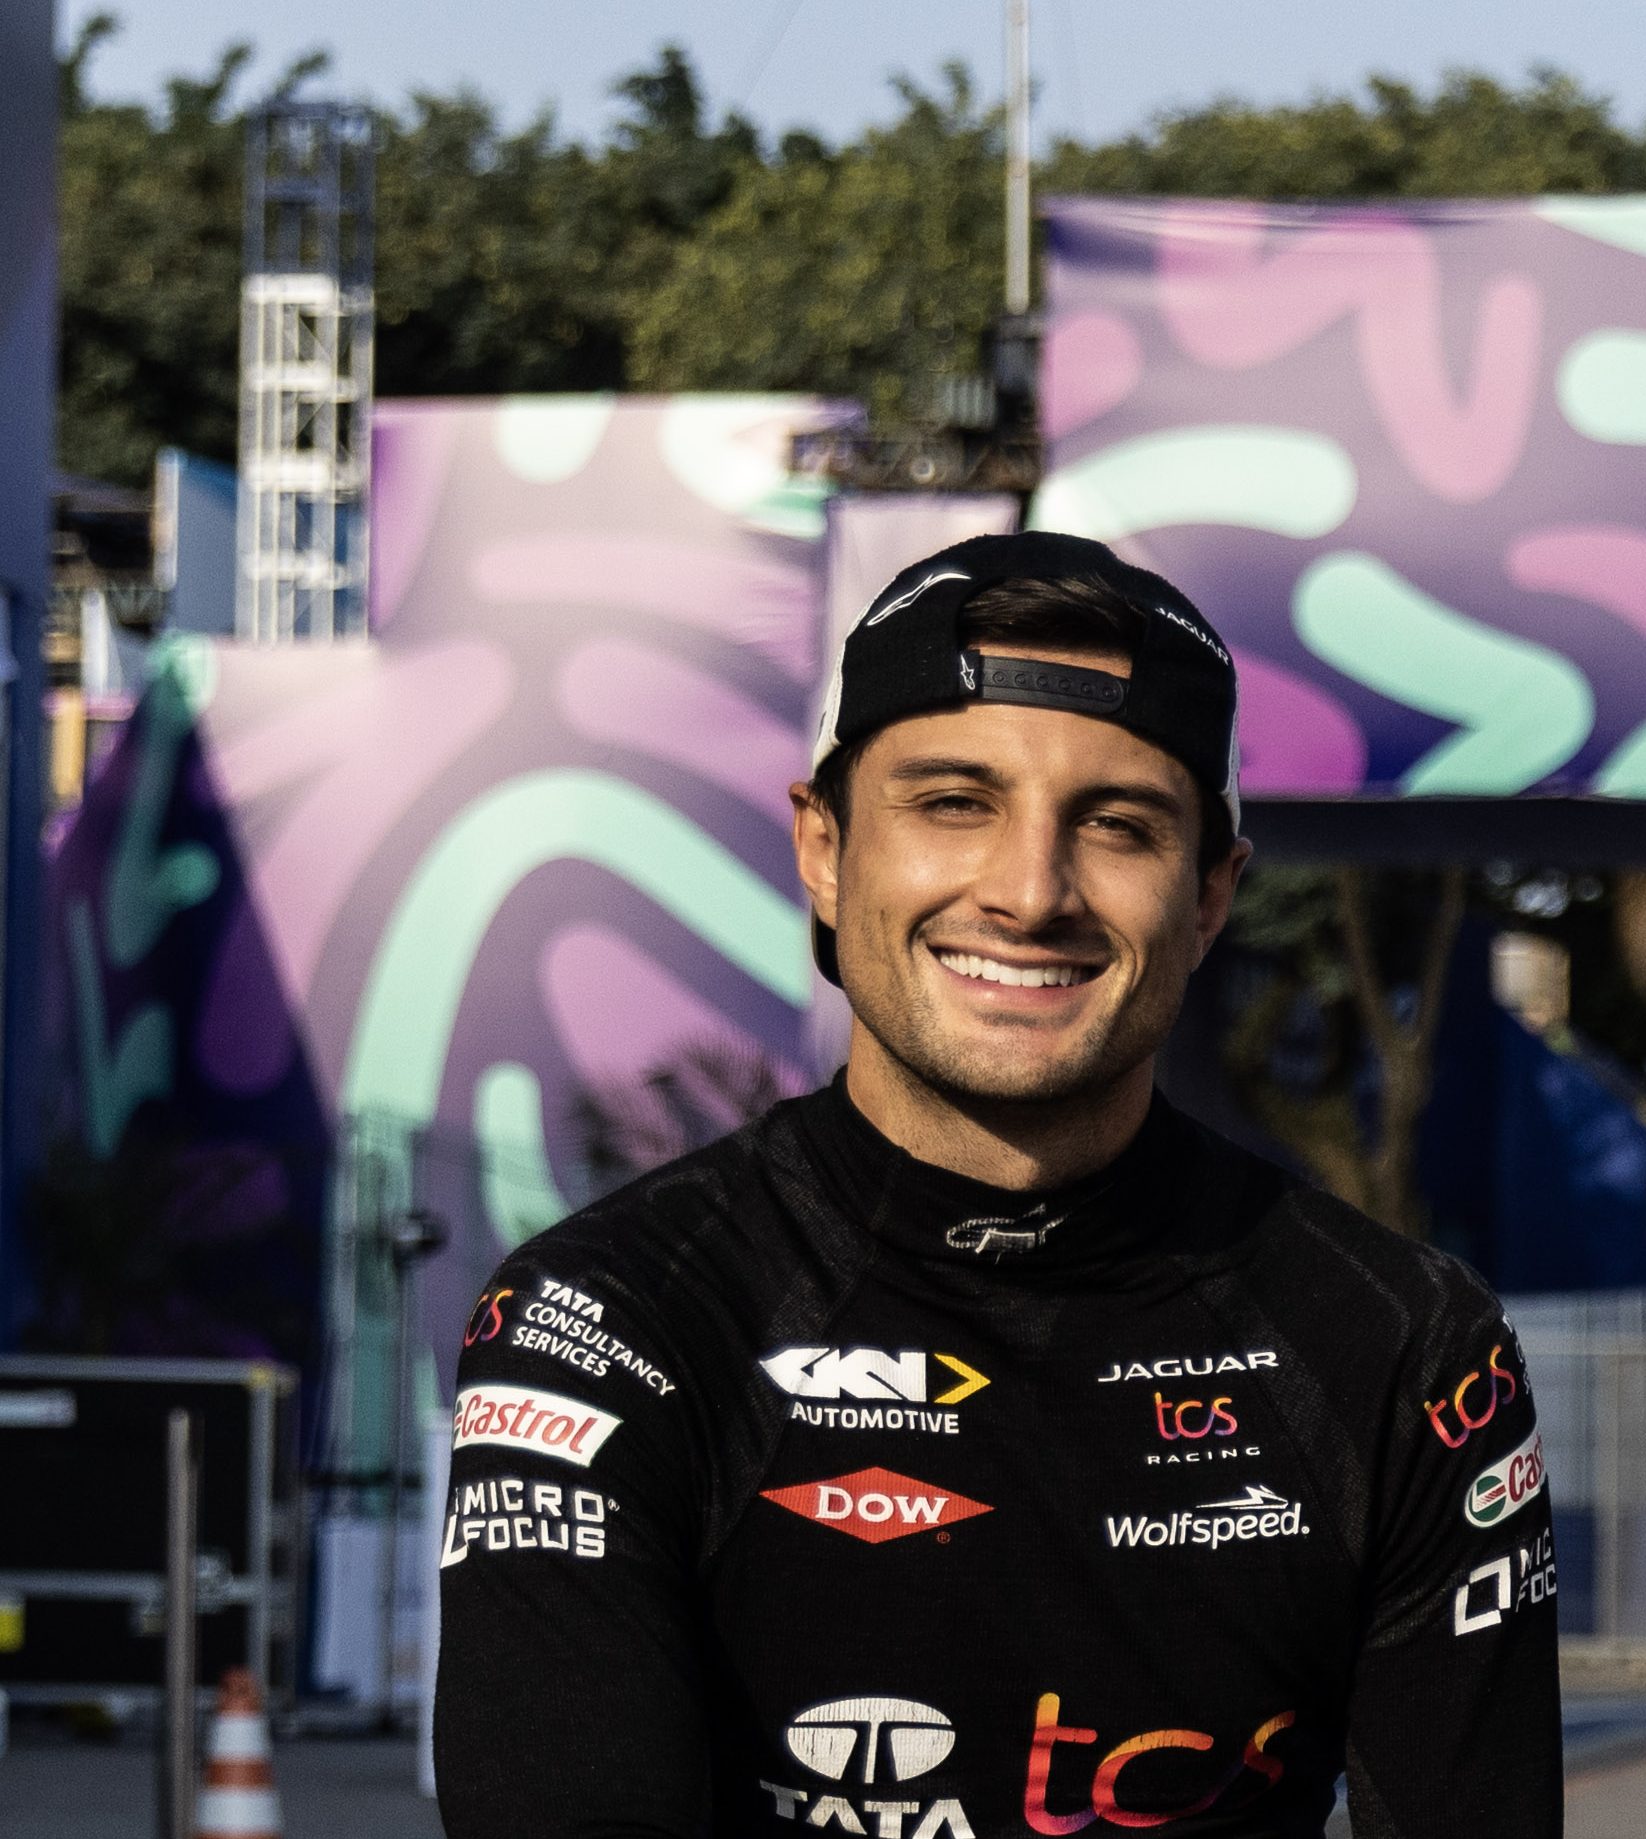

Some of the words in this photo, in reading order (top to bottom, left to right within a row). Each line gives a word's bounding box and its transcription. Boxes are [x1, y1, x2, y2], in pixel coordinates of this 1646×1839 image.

[1155, 607, 1229, 666] JAGUAR
[463, 1288, 514, 1347] cs
[541, 1279, 604, 1323] TATA
[512, 1326, 611, 1377] SERVICES
[523, 1302, 676, 1396] CONSULTANCY
[1098, 1351, 1279, 1382] JAGUAR
[791, 1402, 960, 1434] AUTOMOTIVE
[1154, 1391, 1239, 1440] tcs
[1423, 1344, 1517, 1449] tcs
[461, 1394, 599, 1454] Castrol
[1147, 1446, 1261, 1465] RACING
[463, 1479, 605, 1523] MICRO
[462, 1517, 606, 1558] FOCUS
[1024, 1692, 1296, 1837] tcs
[760, 1778, 976, 1839] TATA
